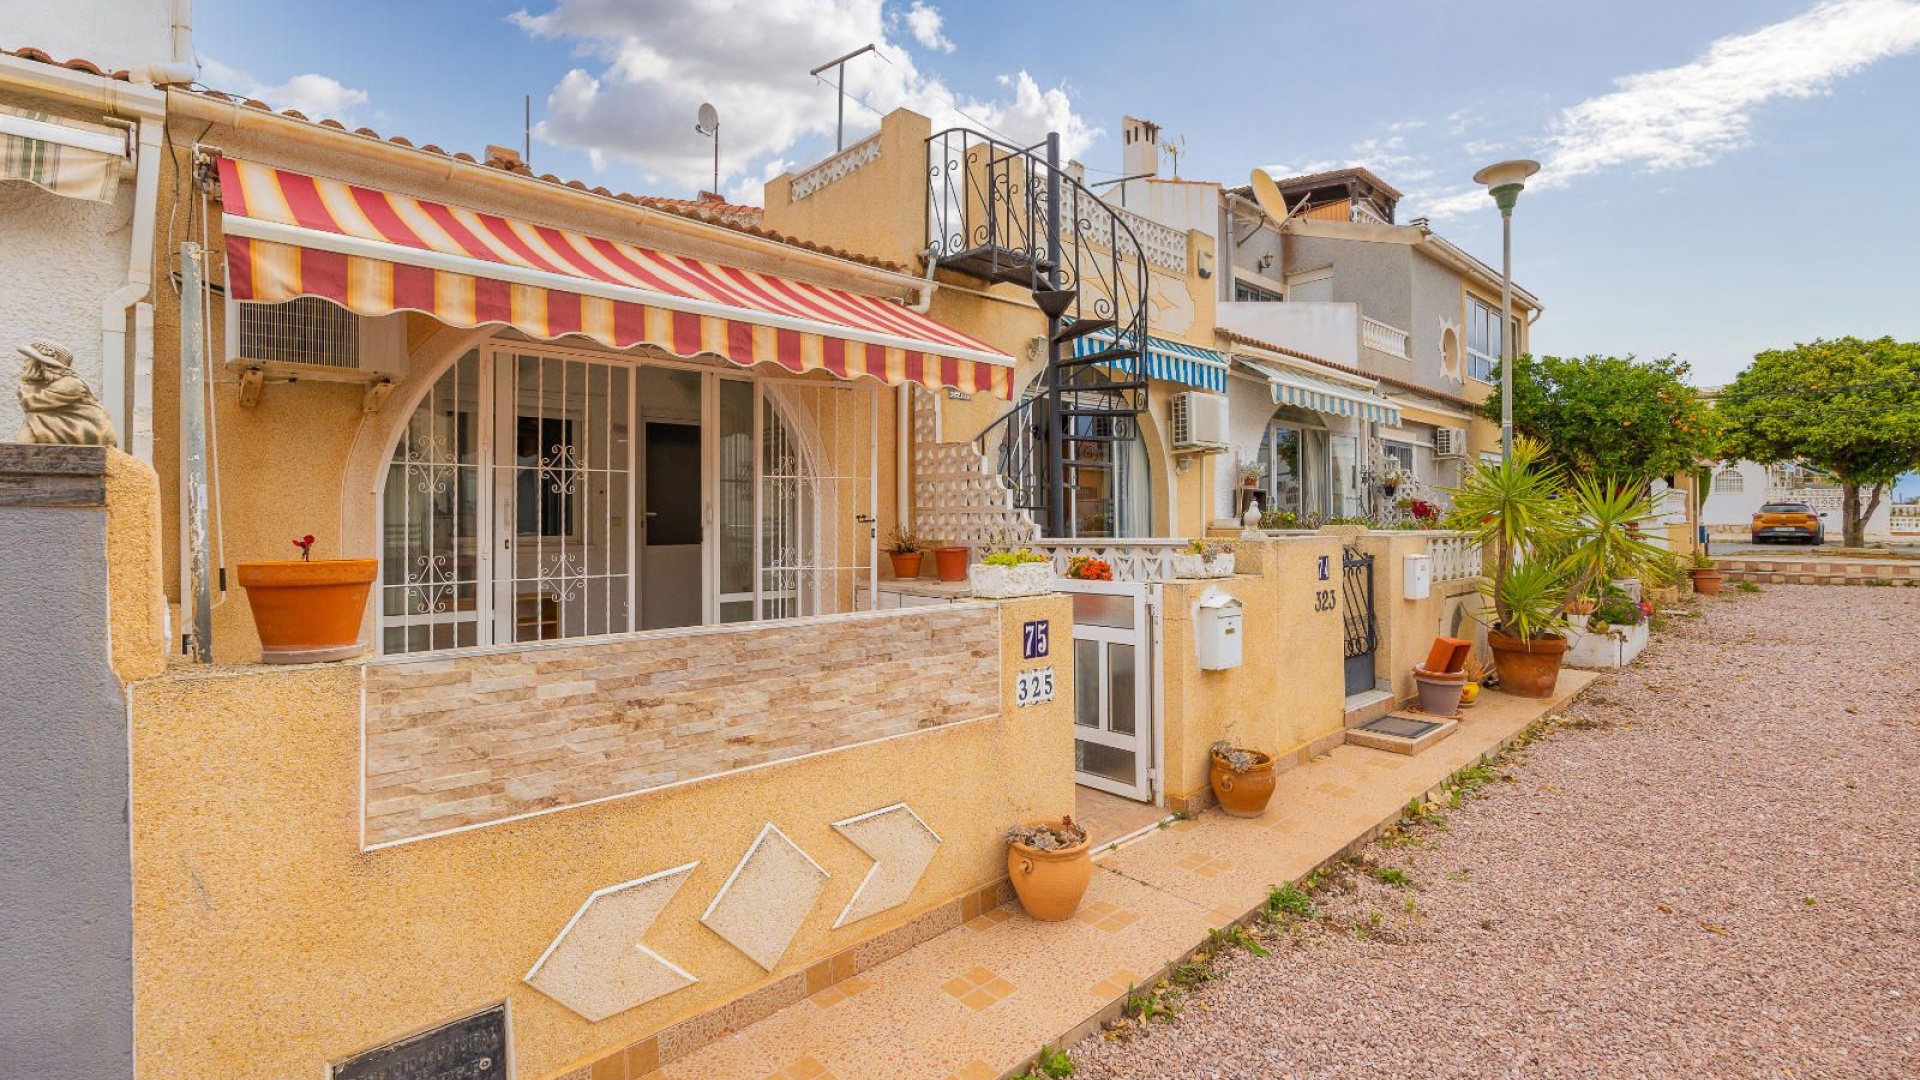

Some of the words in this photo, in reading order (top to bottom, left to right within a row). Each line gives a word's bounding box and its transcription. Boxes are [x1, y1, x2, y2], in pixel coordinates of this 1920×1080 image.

[1315, 590, 1336, 612] 323
[1025, 623, 1047, 657] 75
[1018, 674, 1053, 701] 325
